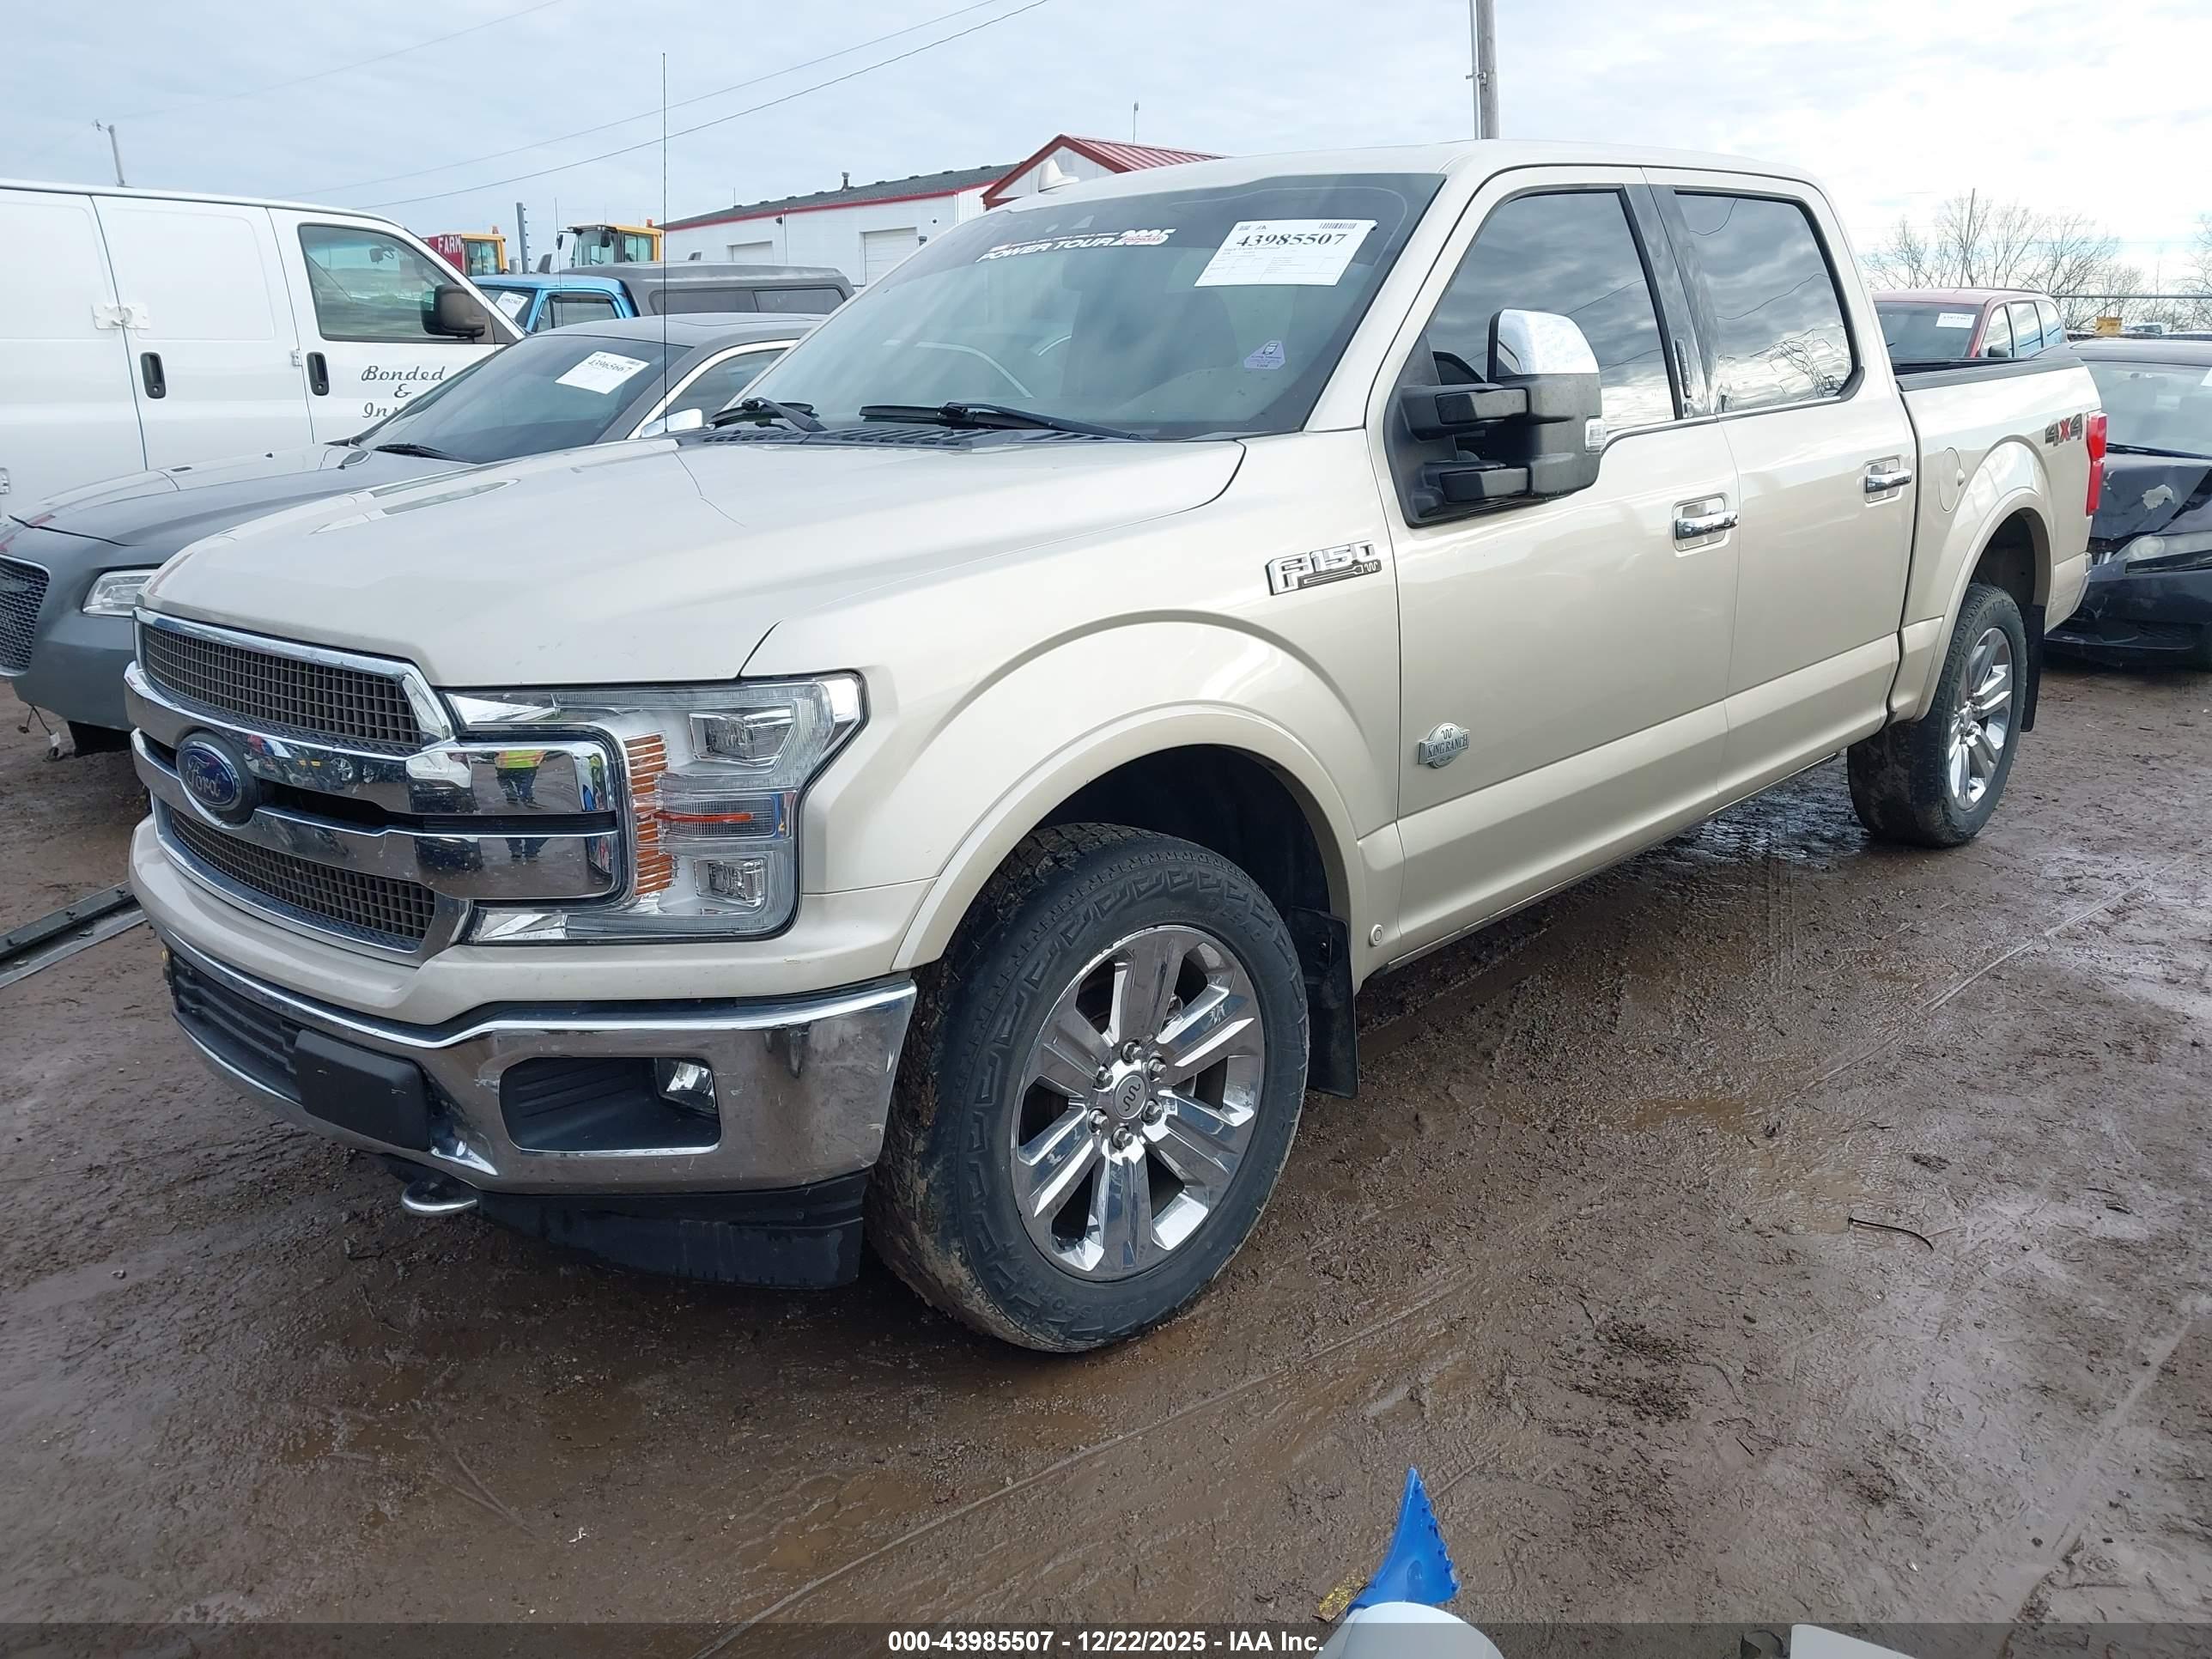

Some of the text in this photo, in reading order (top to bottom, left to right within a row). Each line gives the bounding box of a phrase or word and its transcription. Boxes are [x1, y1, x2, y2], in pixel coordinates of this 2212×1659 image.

[437, 234, 462, 255] FARM
[1236, 233, 1349, 247] 43985507
[975, 242, 1054, 263] POWER
[1053, 236, 1115, 251] TOUR
[361, 365, 446, 381] Bonded
[393, 383, 412, 398] &
[185, 754, 222, 799] Ford
